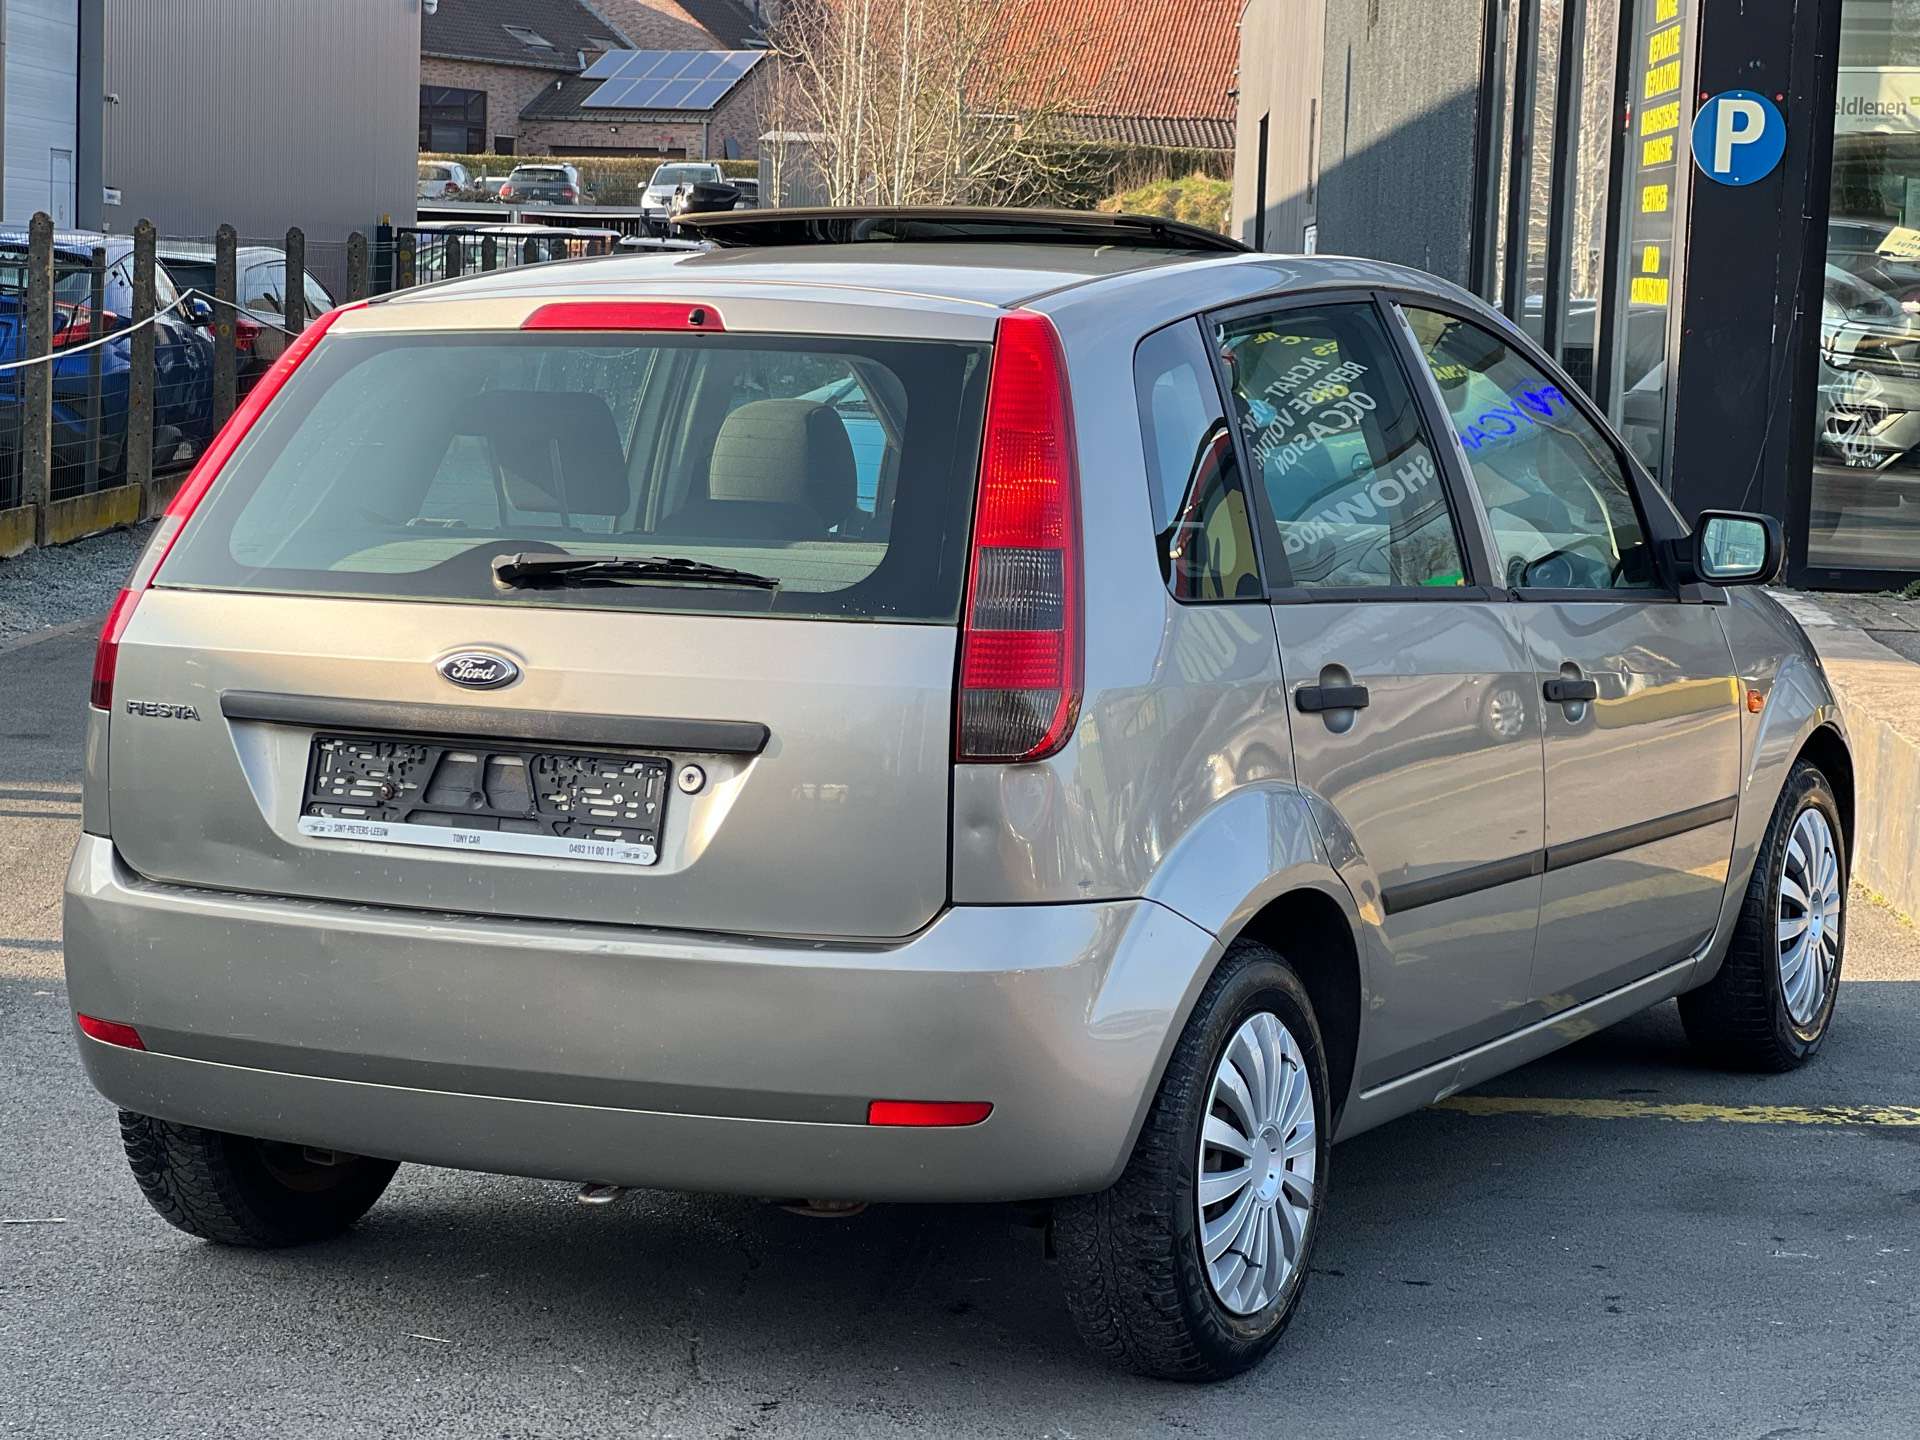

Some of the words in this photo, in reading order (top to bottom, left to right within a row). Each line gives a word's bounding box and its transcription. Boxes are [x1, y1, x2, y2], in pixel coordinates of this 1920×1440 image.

[1714, 98, 1766, 173] P
[452, 658, 497, 680] Ford
[126, 699, 201, 721] FIESTA
[453, 833, 468, 844] TONY
[468, 835, 481, 845] CAR
[568, 843, 586, 854] 0493
[587, 846, 595, 855] 11
[595, 847, 605, 856] 00
[606, 847, 614, 857] 11
